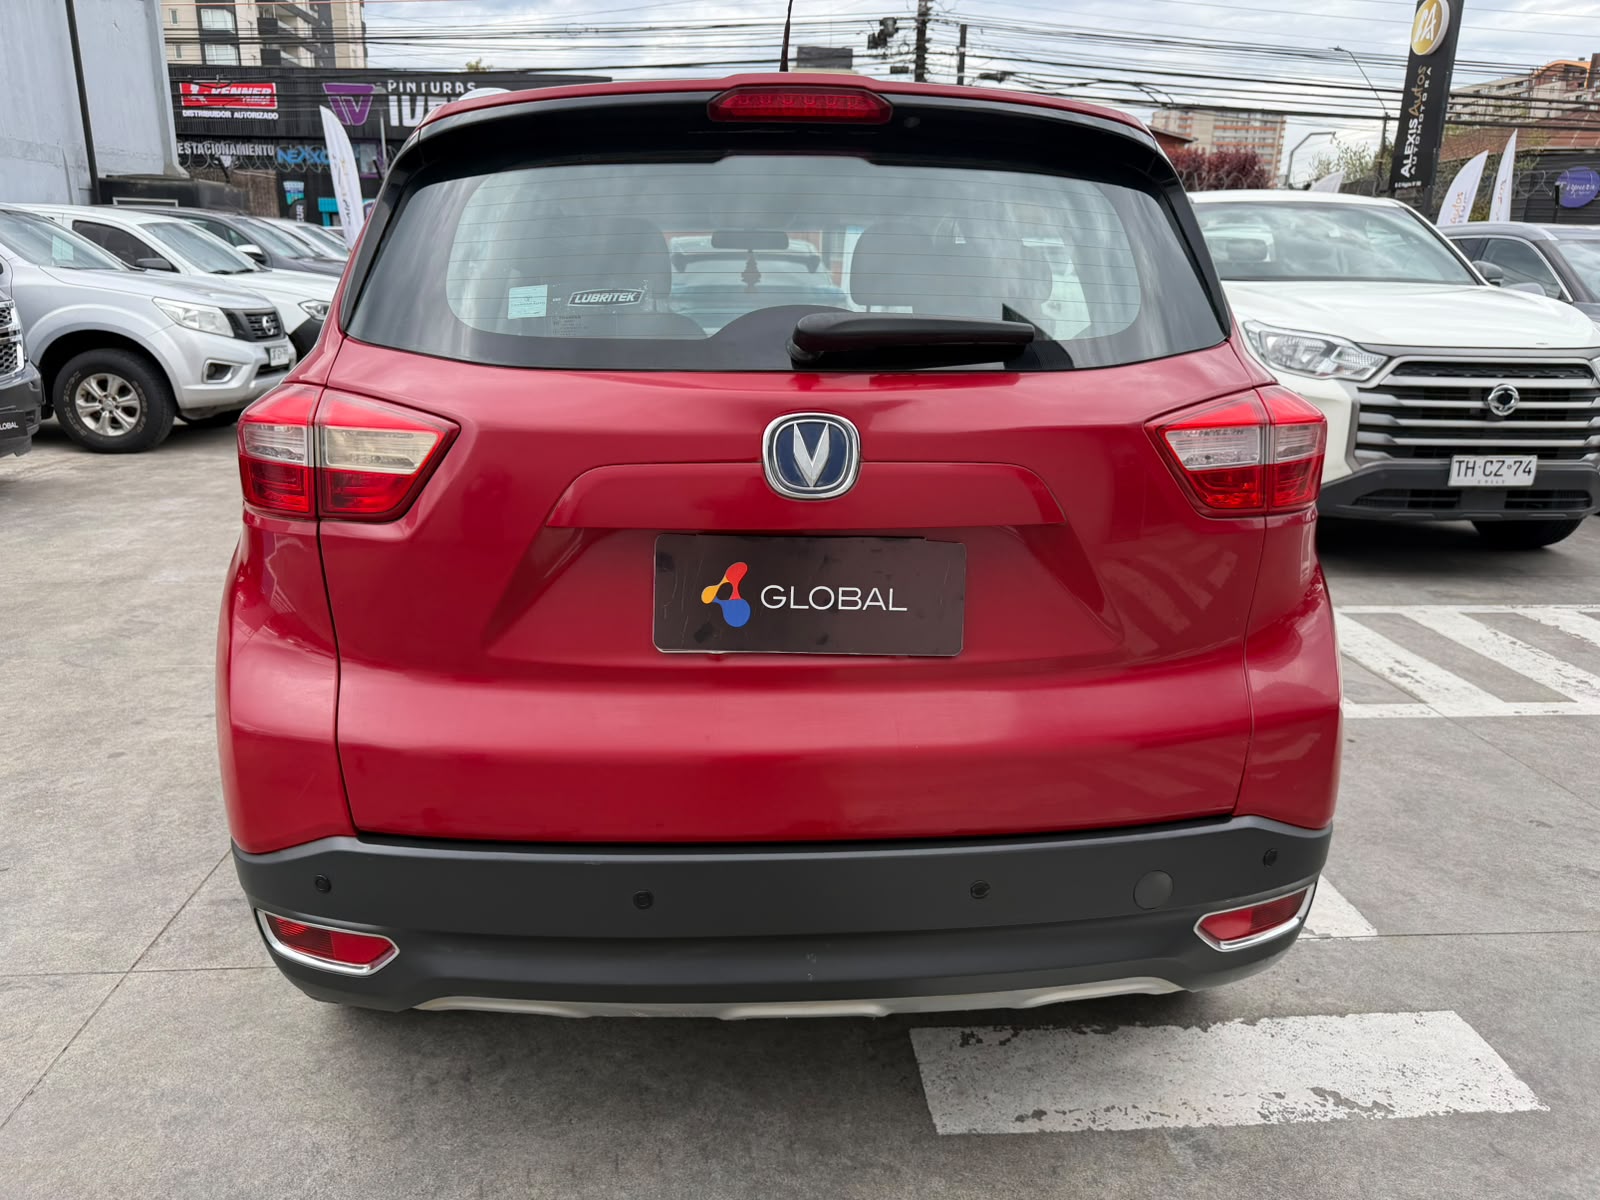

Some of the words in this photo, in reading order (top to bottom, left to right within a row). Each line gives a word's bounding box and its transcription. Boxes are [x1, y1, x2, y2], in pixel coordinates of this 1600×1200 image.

[387, 80, 476, 94] PINTURAS
[1408, 65, 1427, 117] Autos
[182, 109, 232, 118] DISTRIBUIDOR
[233, 111, 279, 119] AUTORIZADO
[1410, 66, 1432, 175] AUTOMOTORA
[178, 143, 275, 156] ESTACIONAMIENTO
[1401, 118, 1418, 178] ALEXIS
[0, 421, 19, 430] LOBAL
[760, 584, 908, 612] GLOBAL
